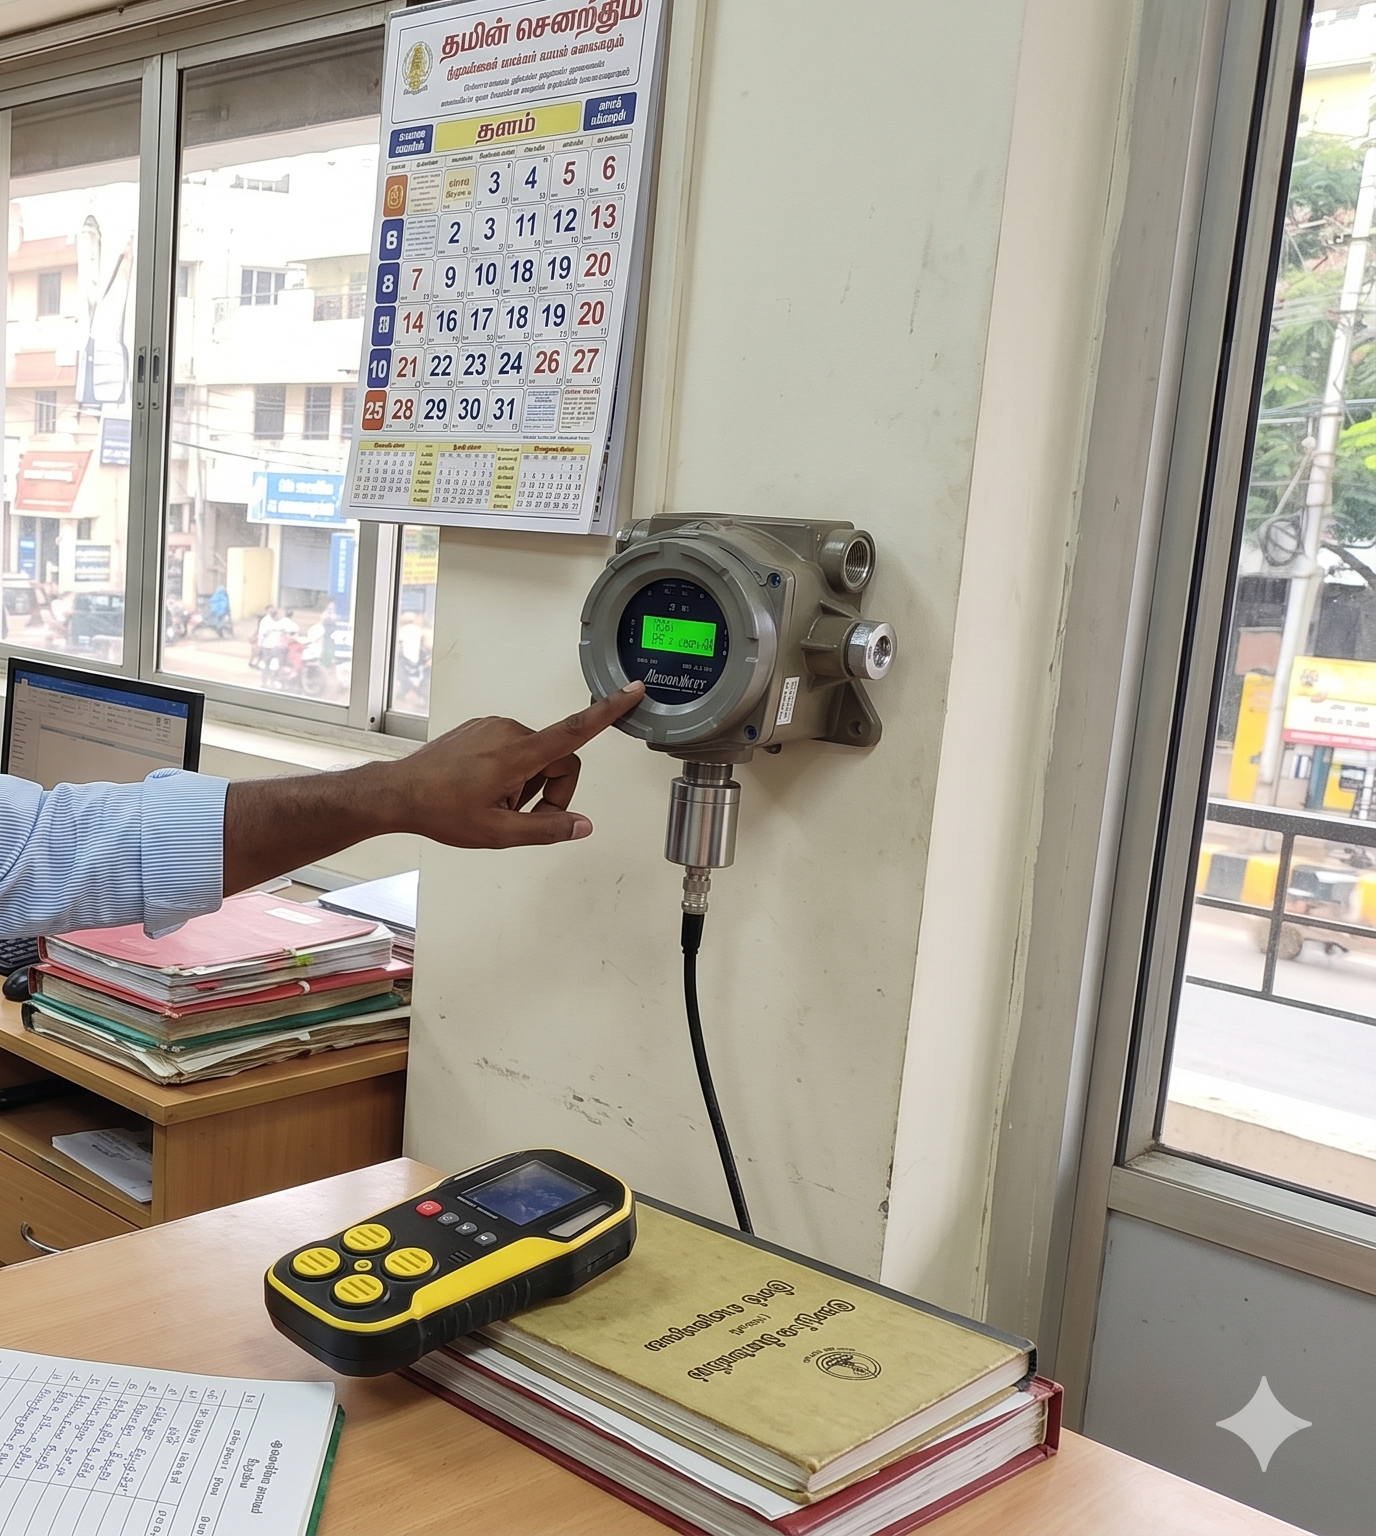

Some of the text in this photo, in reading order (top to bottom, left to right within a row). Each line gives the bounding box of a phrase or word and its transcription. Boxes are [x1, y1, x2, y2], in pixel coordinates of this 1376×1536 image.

[488, 171, 501, 195] 3
[524, 165, 538, 190] 4
[562, 161, 576, 185] 5
[602, 155, 616, 181] 6
[386, 203, 617, 250] 6 2 3 11 12 13
[382, 251, 611, 293] 8 7 9 10 18 19 20
[403, 310, 424, 334] 14
[436, 309, 458, 333] 16
[470, 307, 494, 331] 17
[505, 305, 529, 329] 18
[541, 303, 566, 328] 19
[577, 300, 605, 326] 20
[369, 348, 600, 379] 10 21 22 23 24 26 27
[364, 401, 384, 420] 25
[391, 398, 414, 420] 28
[423, 398, 447, 421] 29
[457, 397, 481, 421] 30
[492, 397, 516, 421] 31
